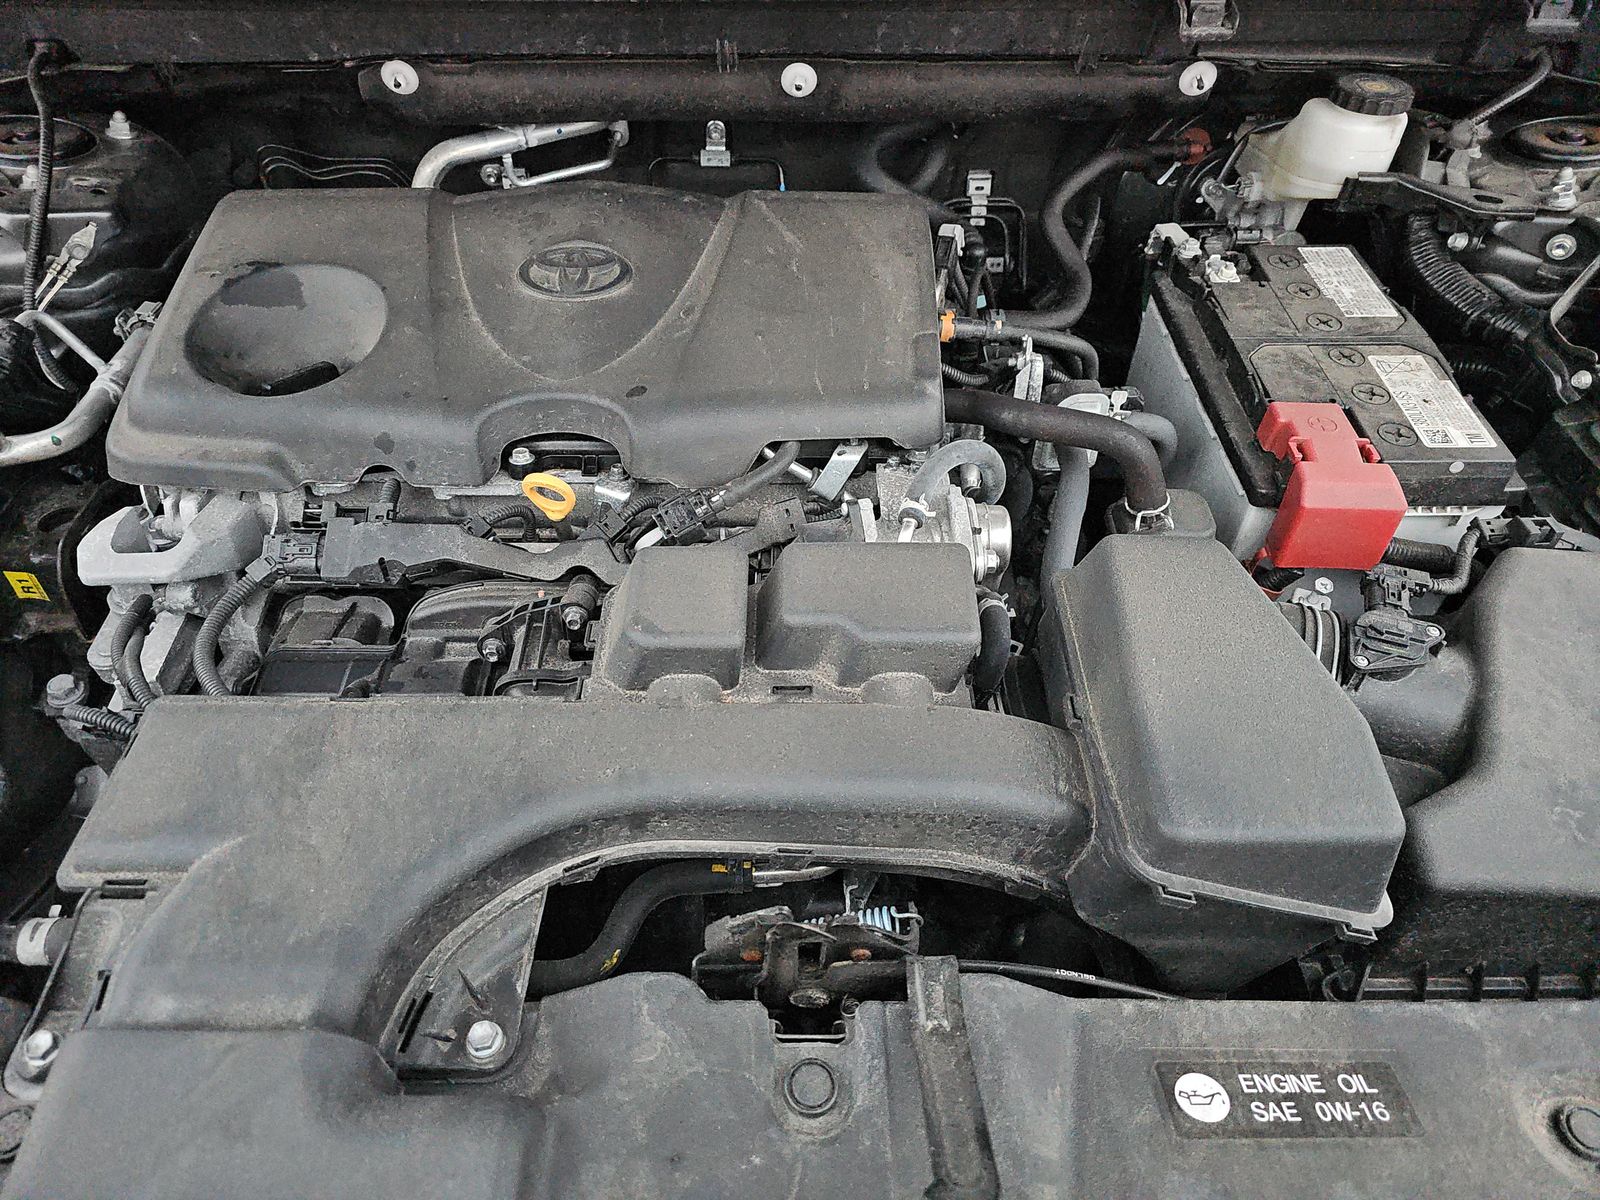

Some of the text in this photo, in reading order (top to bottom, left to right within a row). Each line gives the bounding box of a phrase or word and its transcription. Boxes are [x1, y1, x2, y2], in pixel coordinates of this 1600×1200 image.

[1238, 1073, 1379, 1094] ENGINE OIL
[1250, 1101, 1391, 1123] SAE 0W-16
